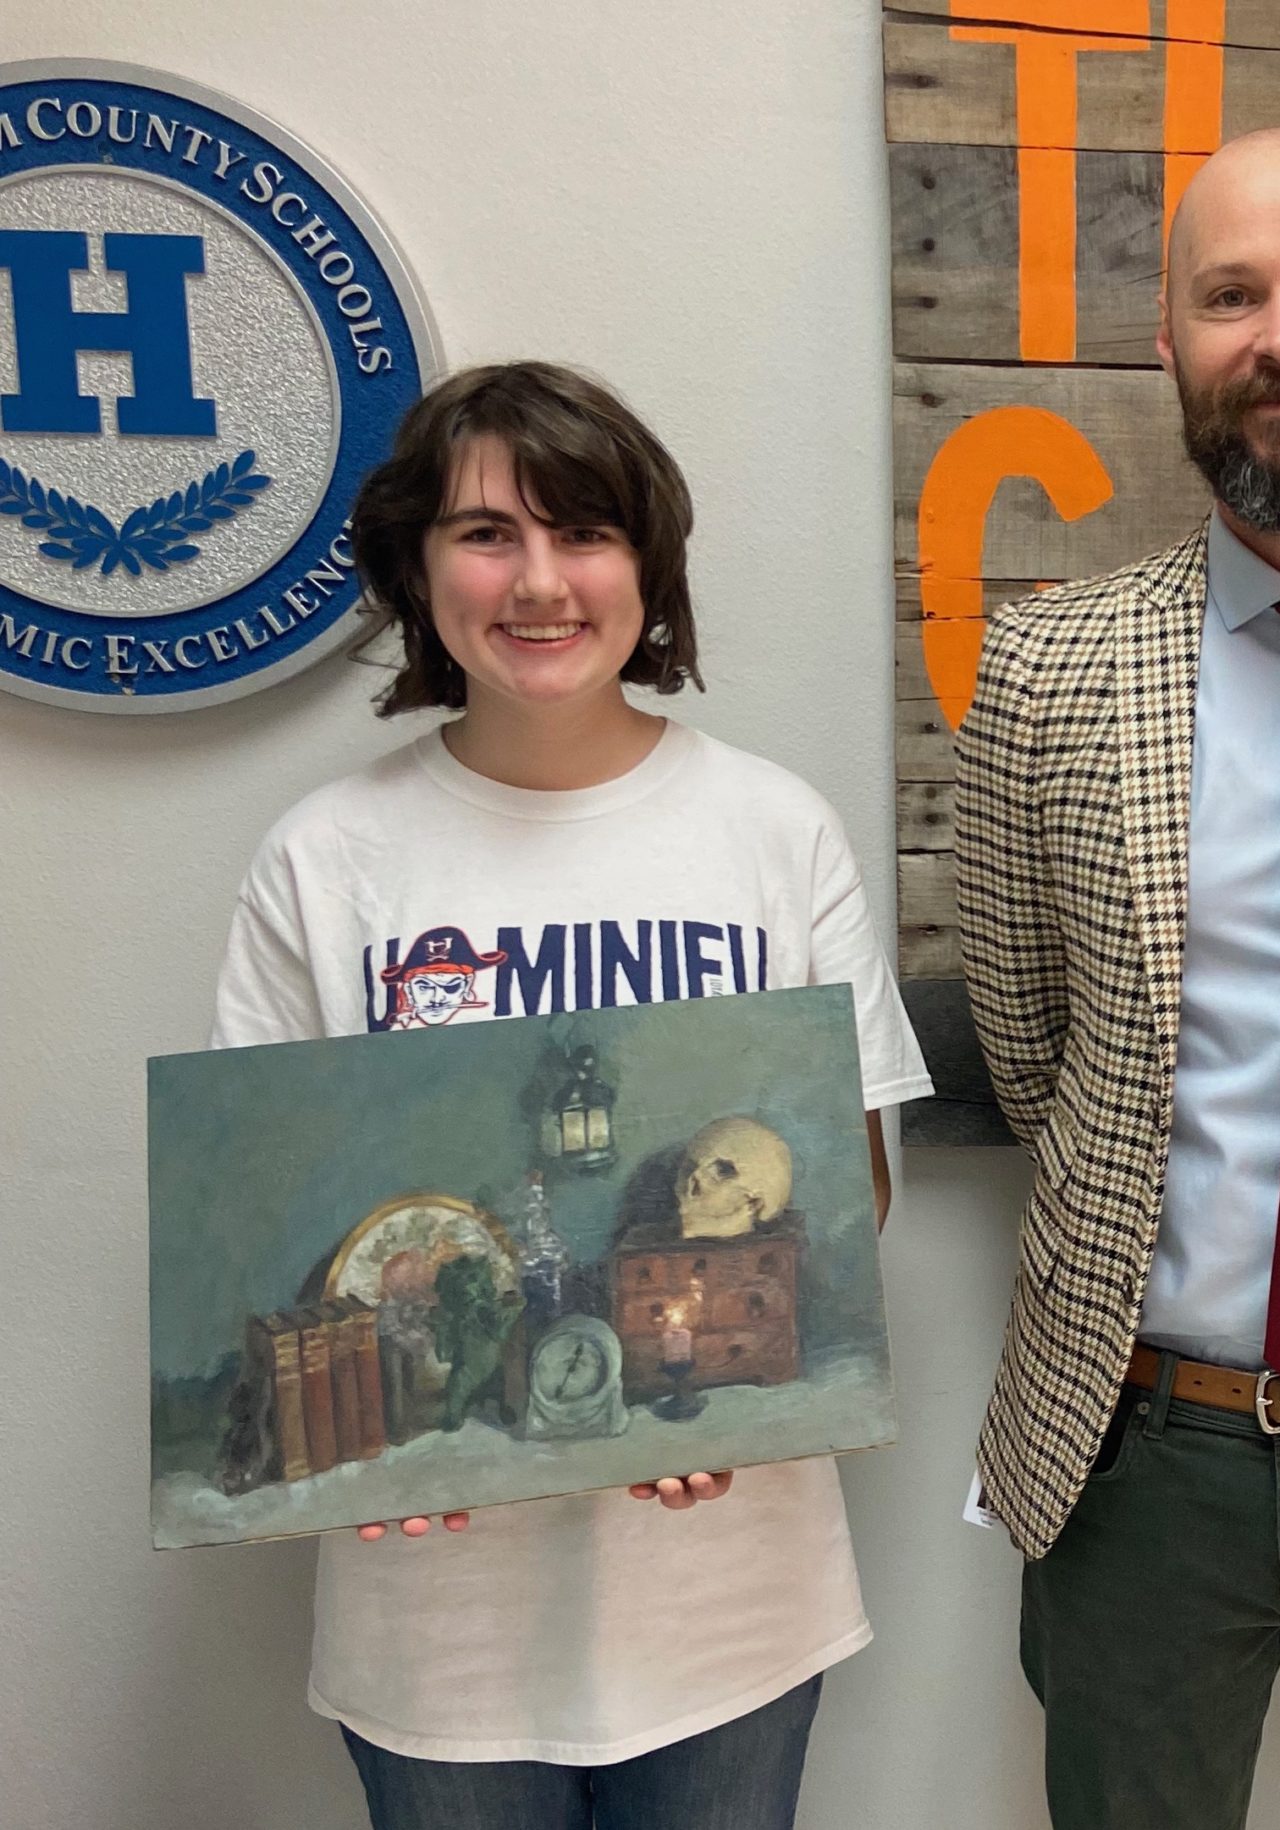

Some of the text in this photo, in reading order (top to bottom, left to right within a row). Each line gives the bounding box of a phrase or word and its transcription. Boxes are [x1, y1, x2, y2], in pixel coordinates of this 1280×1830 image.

[0, 229, 218, 437] H
[26, 97, 392, 375] COUNTY SCHOOLS
[104, 518, 356, 675] EXCELLENC
